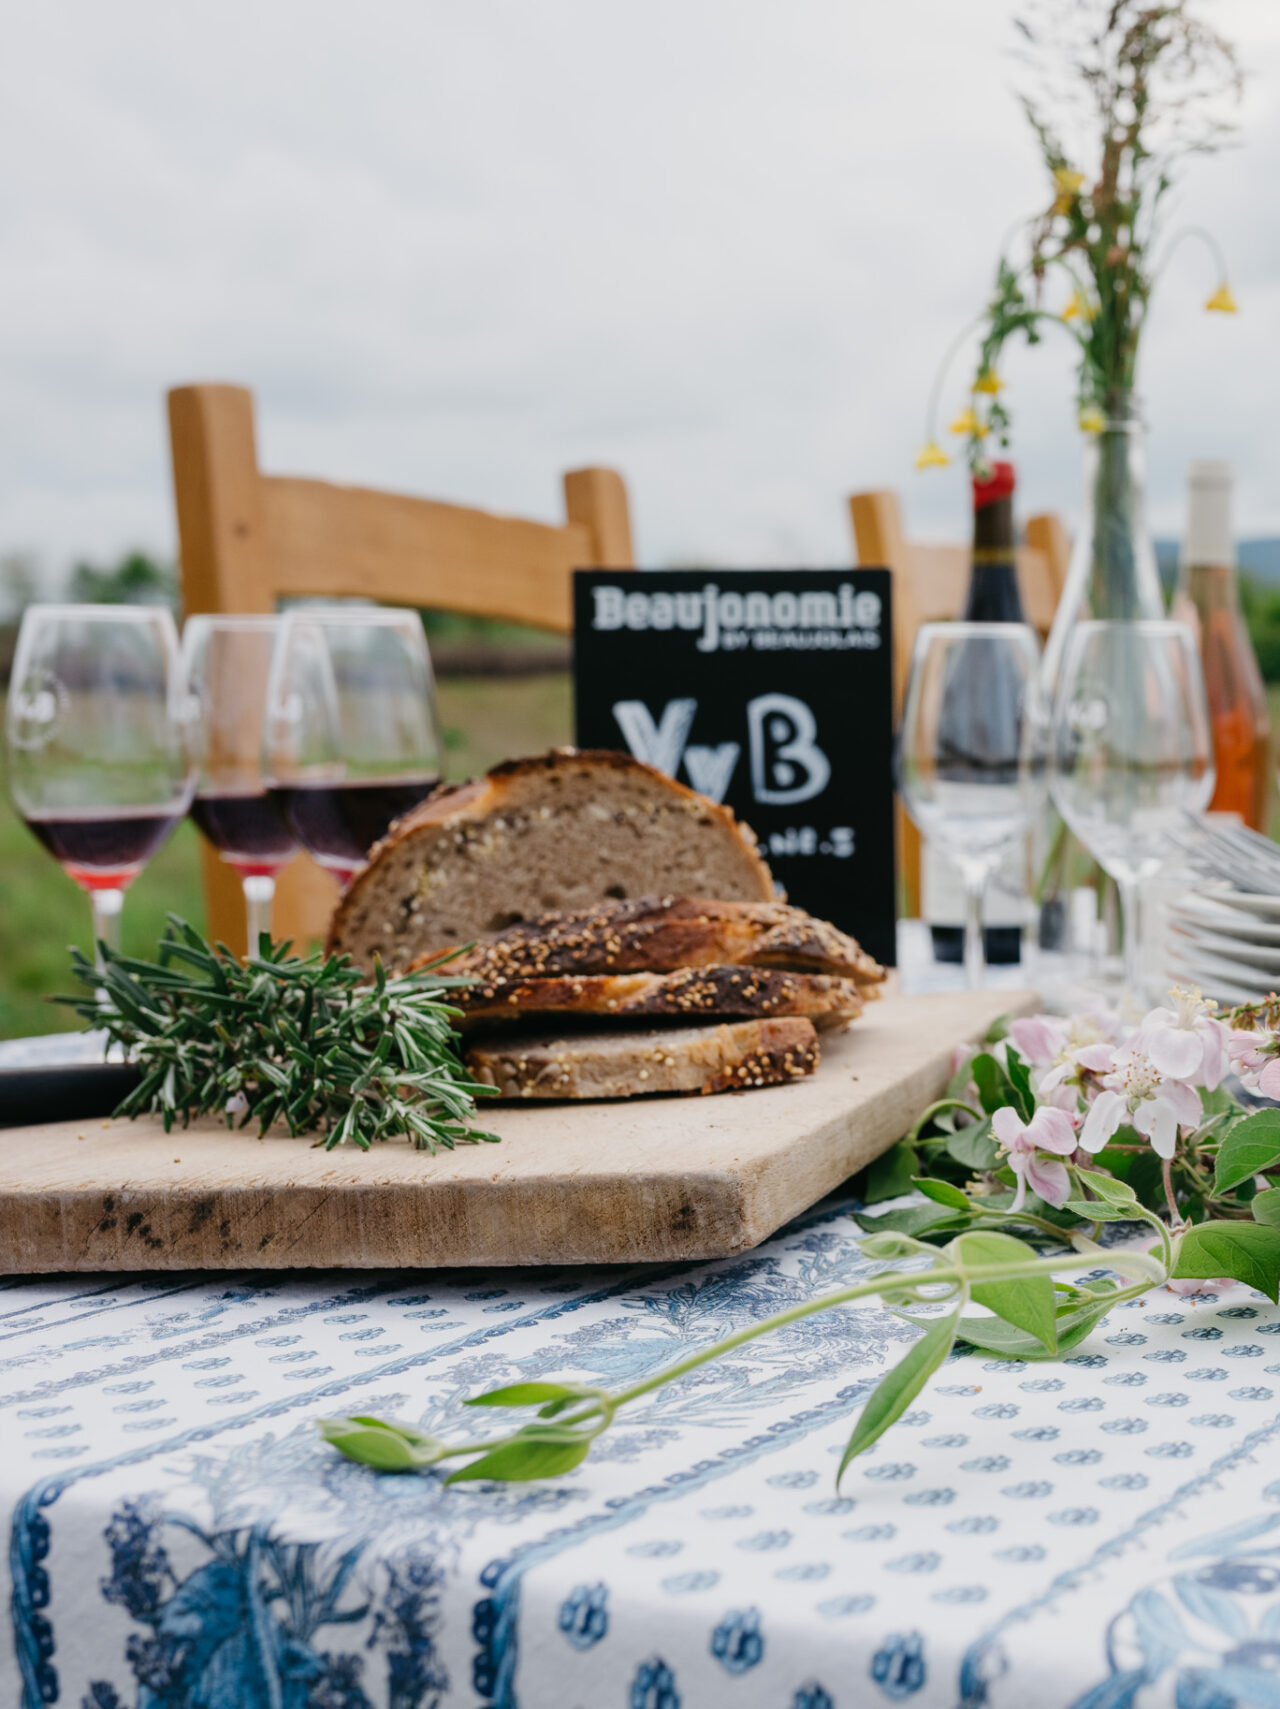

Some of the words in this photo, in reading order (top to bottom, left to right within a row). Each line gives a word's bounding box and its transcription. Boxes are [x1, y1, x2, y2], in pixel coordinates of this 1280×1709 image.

[592, 582, 882, 652] Beaujonomie
[721, 631, 748, 650] BY
[752, 631, 881, 650] BEAUJOLAIS
